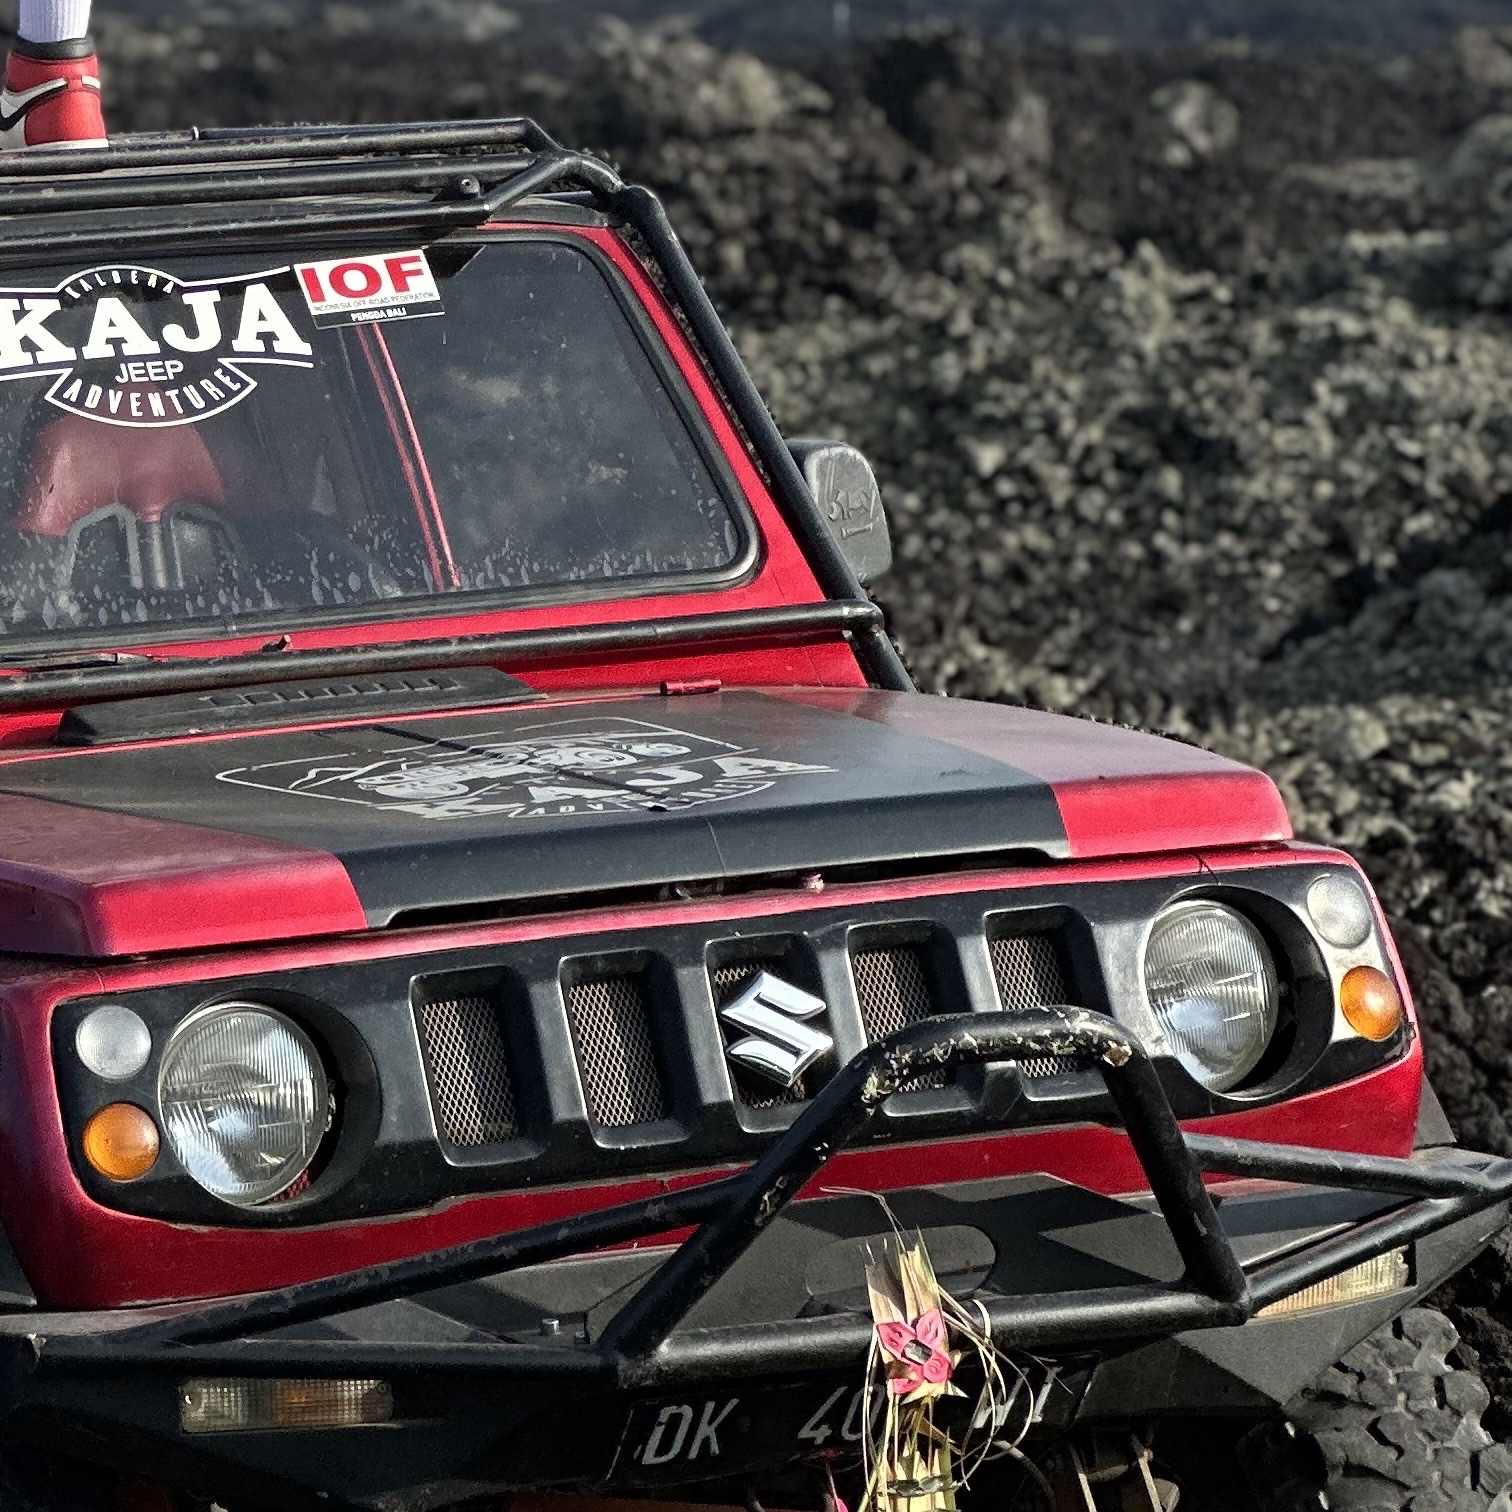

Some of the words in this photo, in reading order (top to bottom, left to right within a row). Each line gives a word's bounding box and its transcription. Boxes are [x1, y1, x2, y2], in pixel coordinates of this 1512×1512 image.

[300, 255, 424, 303] IOF
[387, 306, 407, 318] BALI
[63, 368, 242, 417] ADVENTURE
[115, 360, 184, 383] JEEP
[641, 1398, 740, 1466] DK
